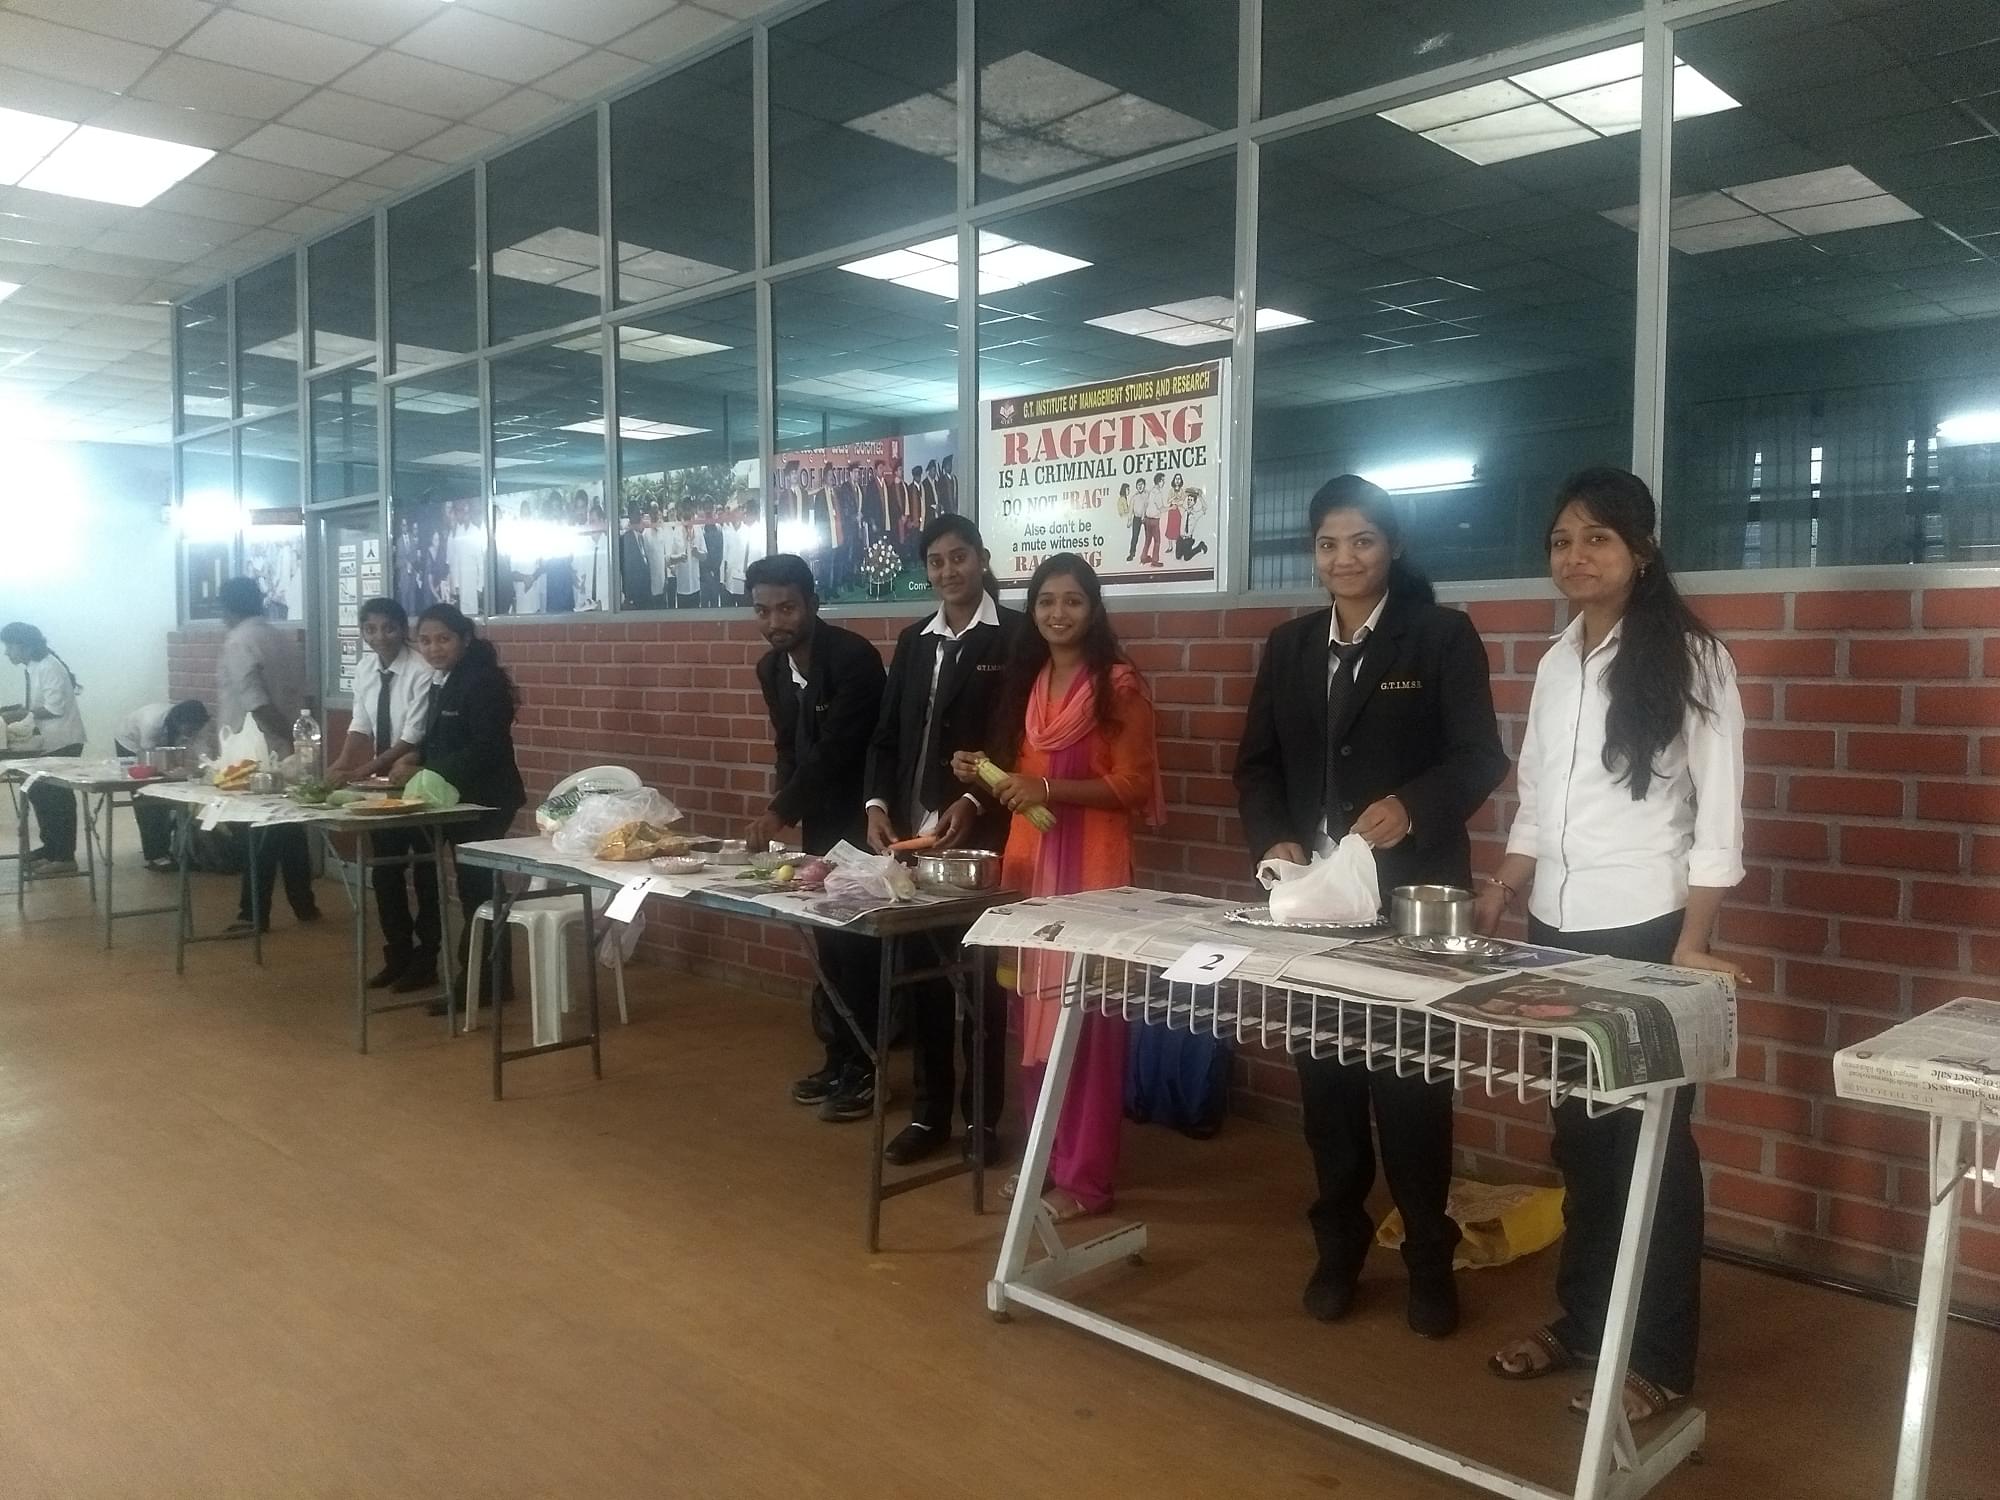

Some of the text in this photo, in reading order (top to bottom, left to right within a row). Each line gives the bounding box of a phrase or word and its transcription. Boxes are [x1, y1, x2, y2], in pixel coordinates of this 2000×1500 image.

[1035, 395, 1068, 417] INSTITUTE
[1068, 393, 1078, 411] OF
[1079, 386, 1123, 410] MANAGEMENT
[1125, 381, 1154, 403] STUDIES
[1155, 378, 1170, 398] AND
[1172, 371, 1210, 394] RESEARCH
[1003, 404, 1204, 466] RAGGING
[998, 445, 1207, 488] IS A CRIMINAL OFFENCE
[800, 467, 815, 489] OF
[1002, 498, 1022, 517] DO
[1027, 494, 1058, 513] NOT
[1024, 518, 1092, 537] Also don't be
[1012, 534, 1104, 552] a mute witness to
[632, 877, 652, 890] 3
[1198, 953, 1225, 971] 2
[1931, 1069, 1953, 1081] sale
[1953, 1073, 1981, 1085] asset
[1953, 1086, 1981, 1100] plans
